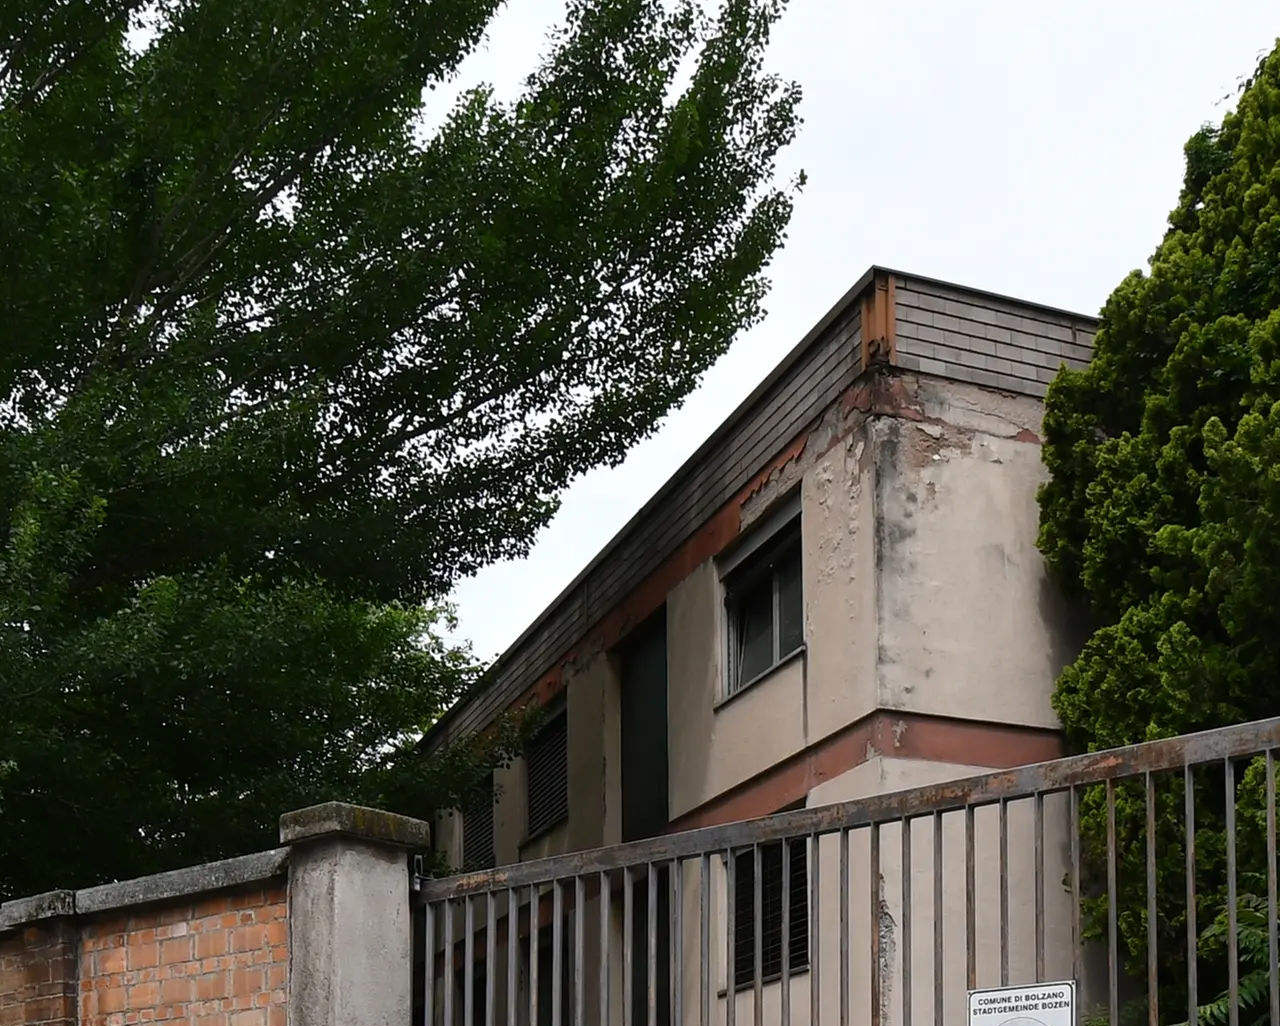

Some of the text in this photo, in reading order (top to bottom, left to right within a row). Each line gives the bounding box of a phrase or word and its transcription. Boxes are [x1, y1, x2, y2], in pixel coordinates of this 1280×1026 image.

[978, 996, 1013, 1006] COMUNE
[1024, 991, 1065, 1001] BOLZANO
[973, 1001, 1070, 1015] STADTGEMEINDE BOZEN
